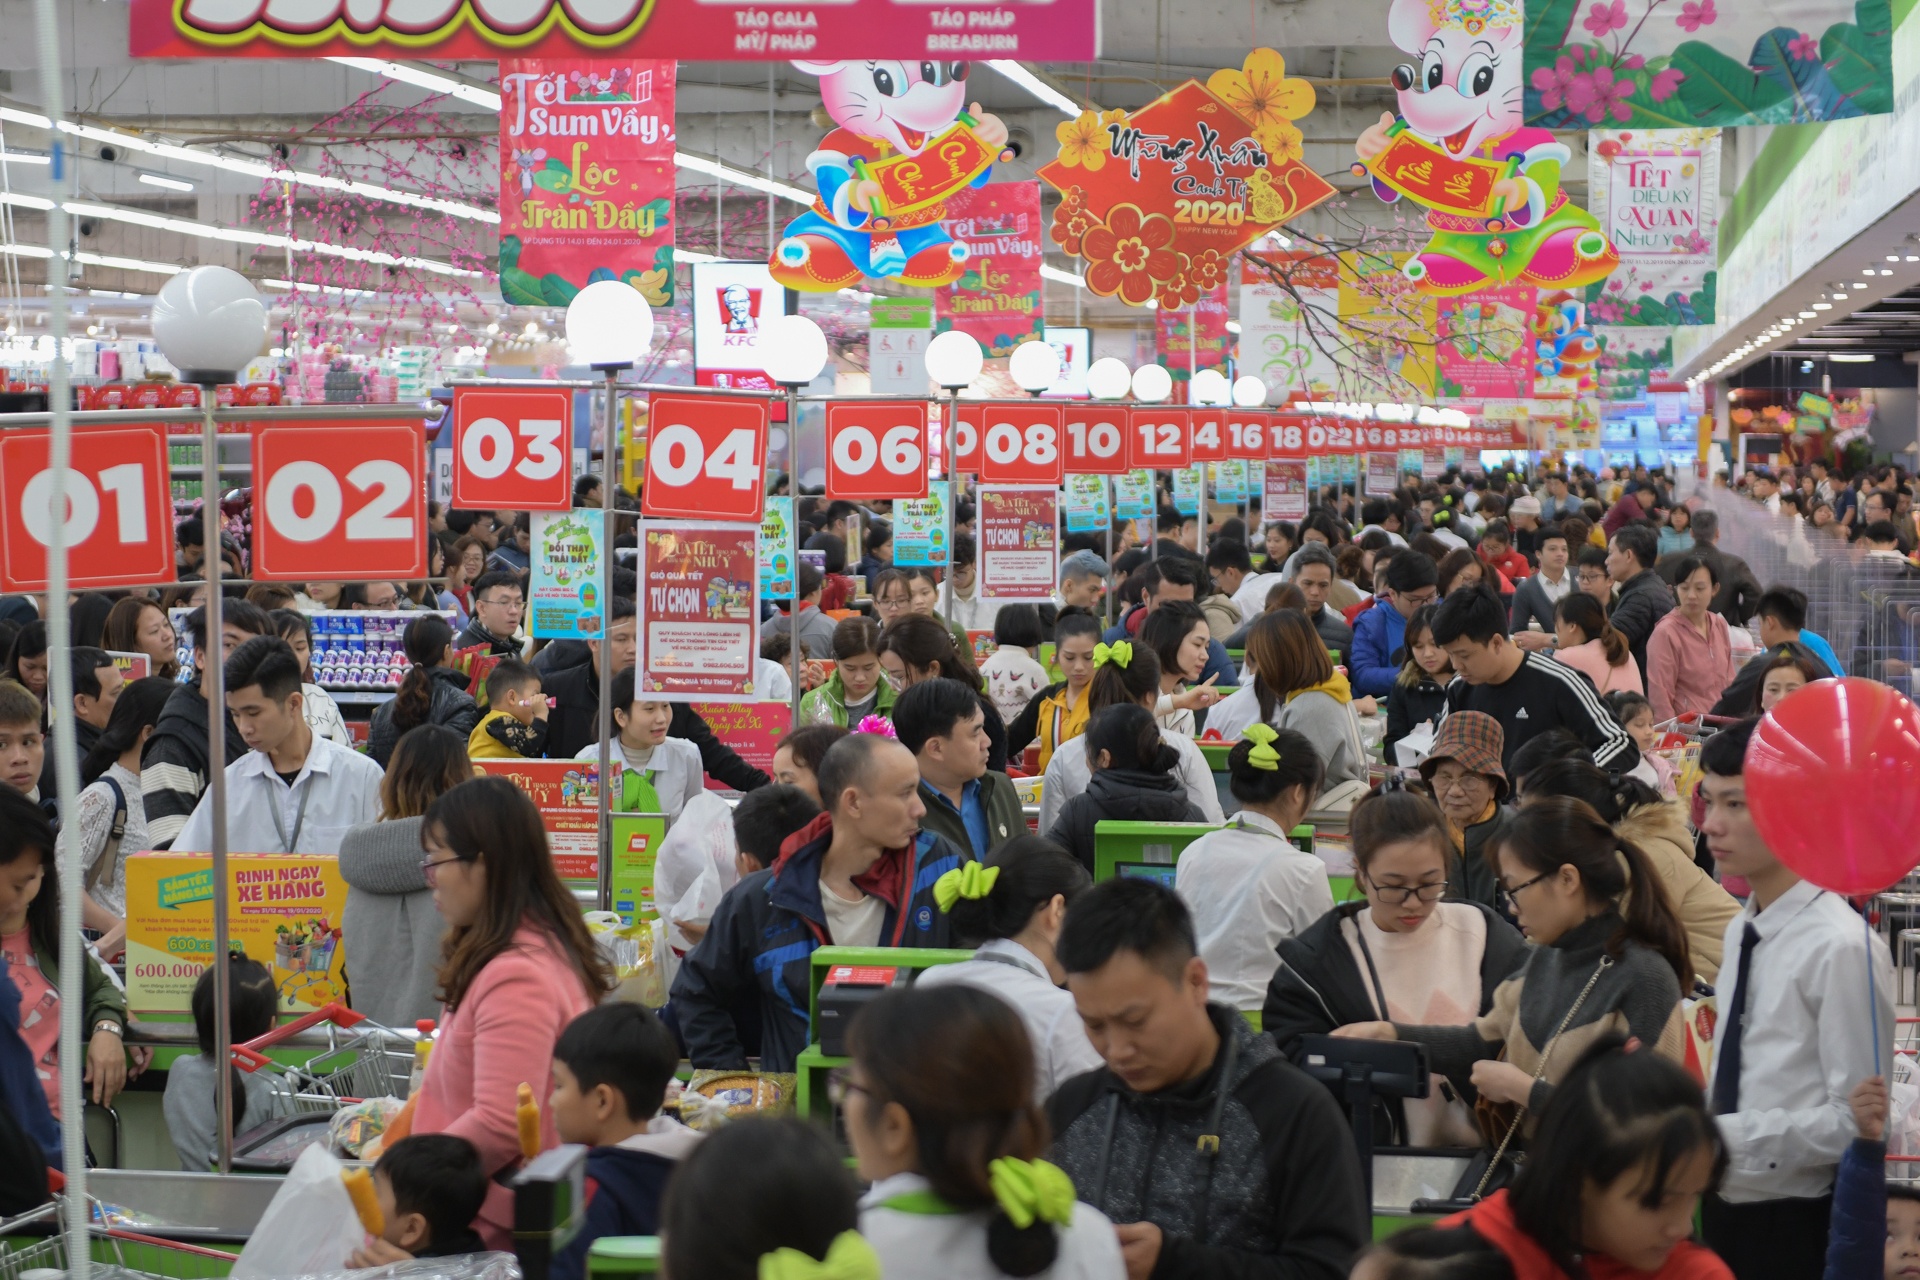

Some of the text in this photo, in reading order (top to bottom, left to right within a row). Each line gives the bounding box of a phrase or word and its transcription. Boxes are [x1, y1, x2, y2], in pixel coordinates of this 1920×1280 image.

[735, 8, 817, 27] TÁO GALA
[931, 8, 1015, 27] TÁO PHÁP
[771, 30, 816, 50] PHÁP
[927, 33, 1017, 51] BREABURN
[502, 71, 568, 135] Tết
[530, 107, 598, 136] Sum
[1107, 121, 1268, 181] Mừng Xuân
[570, 141, 620, 196] Lộc
[1614, 160, 1671, 188] TẾT
[1173, 175, 1224, 197] Canh
[1633, 187, 1670, 205] DIỆU
[522, 199, 656, 237] Tràn Đầy
[1173, 199, 1244, 226] 2020
[1618, 206, 1693, 230] XUÂN
[603, 238, 641, 246] 24.01.2020
[1178, 226, 1200, 235] HAPPY
[968, 242, 995, 256] um
[951, 295, 992, 313] Tràn
[723, 335, 757, 346] KFC
[985, 423, 1057, 465] 08
[1067, 422, 1121, 457] 10
[1139, 423, 1182, 454] 12
[1229, 423, 1263, 448] 16
[1271, 426, 1302, 448] 18
[462, 417, 562, 480] 03
[650, 424, 760, 490] 04
[833, 425, 921, 475] 06
[21, 462, 148, 548] 01
[265, 459, 413, 542] 02
[567, 544, 589, 552] THAY
[690, 540, 716, 554] TẾT
[986, 526, 1019, 549] TỰ CHỌN
[549, 552, 588, 563] TRÁI ĐẤT
[694, 555, 721, 567] NHƯ
[650, 569, 664, 579] GIỎ
[687, 570, 703, 580] TẾT
[651, 582, 699, 619] TỰ CHỌN
[236, 866, 319, 884] RINH NGAY
[238, 879, 325, 902] XE HÀNG
[169, 939, 210, 950] 600 XE
